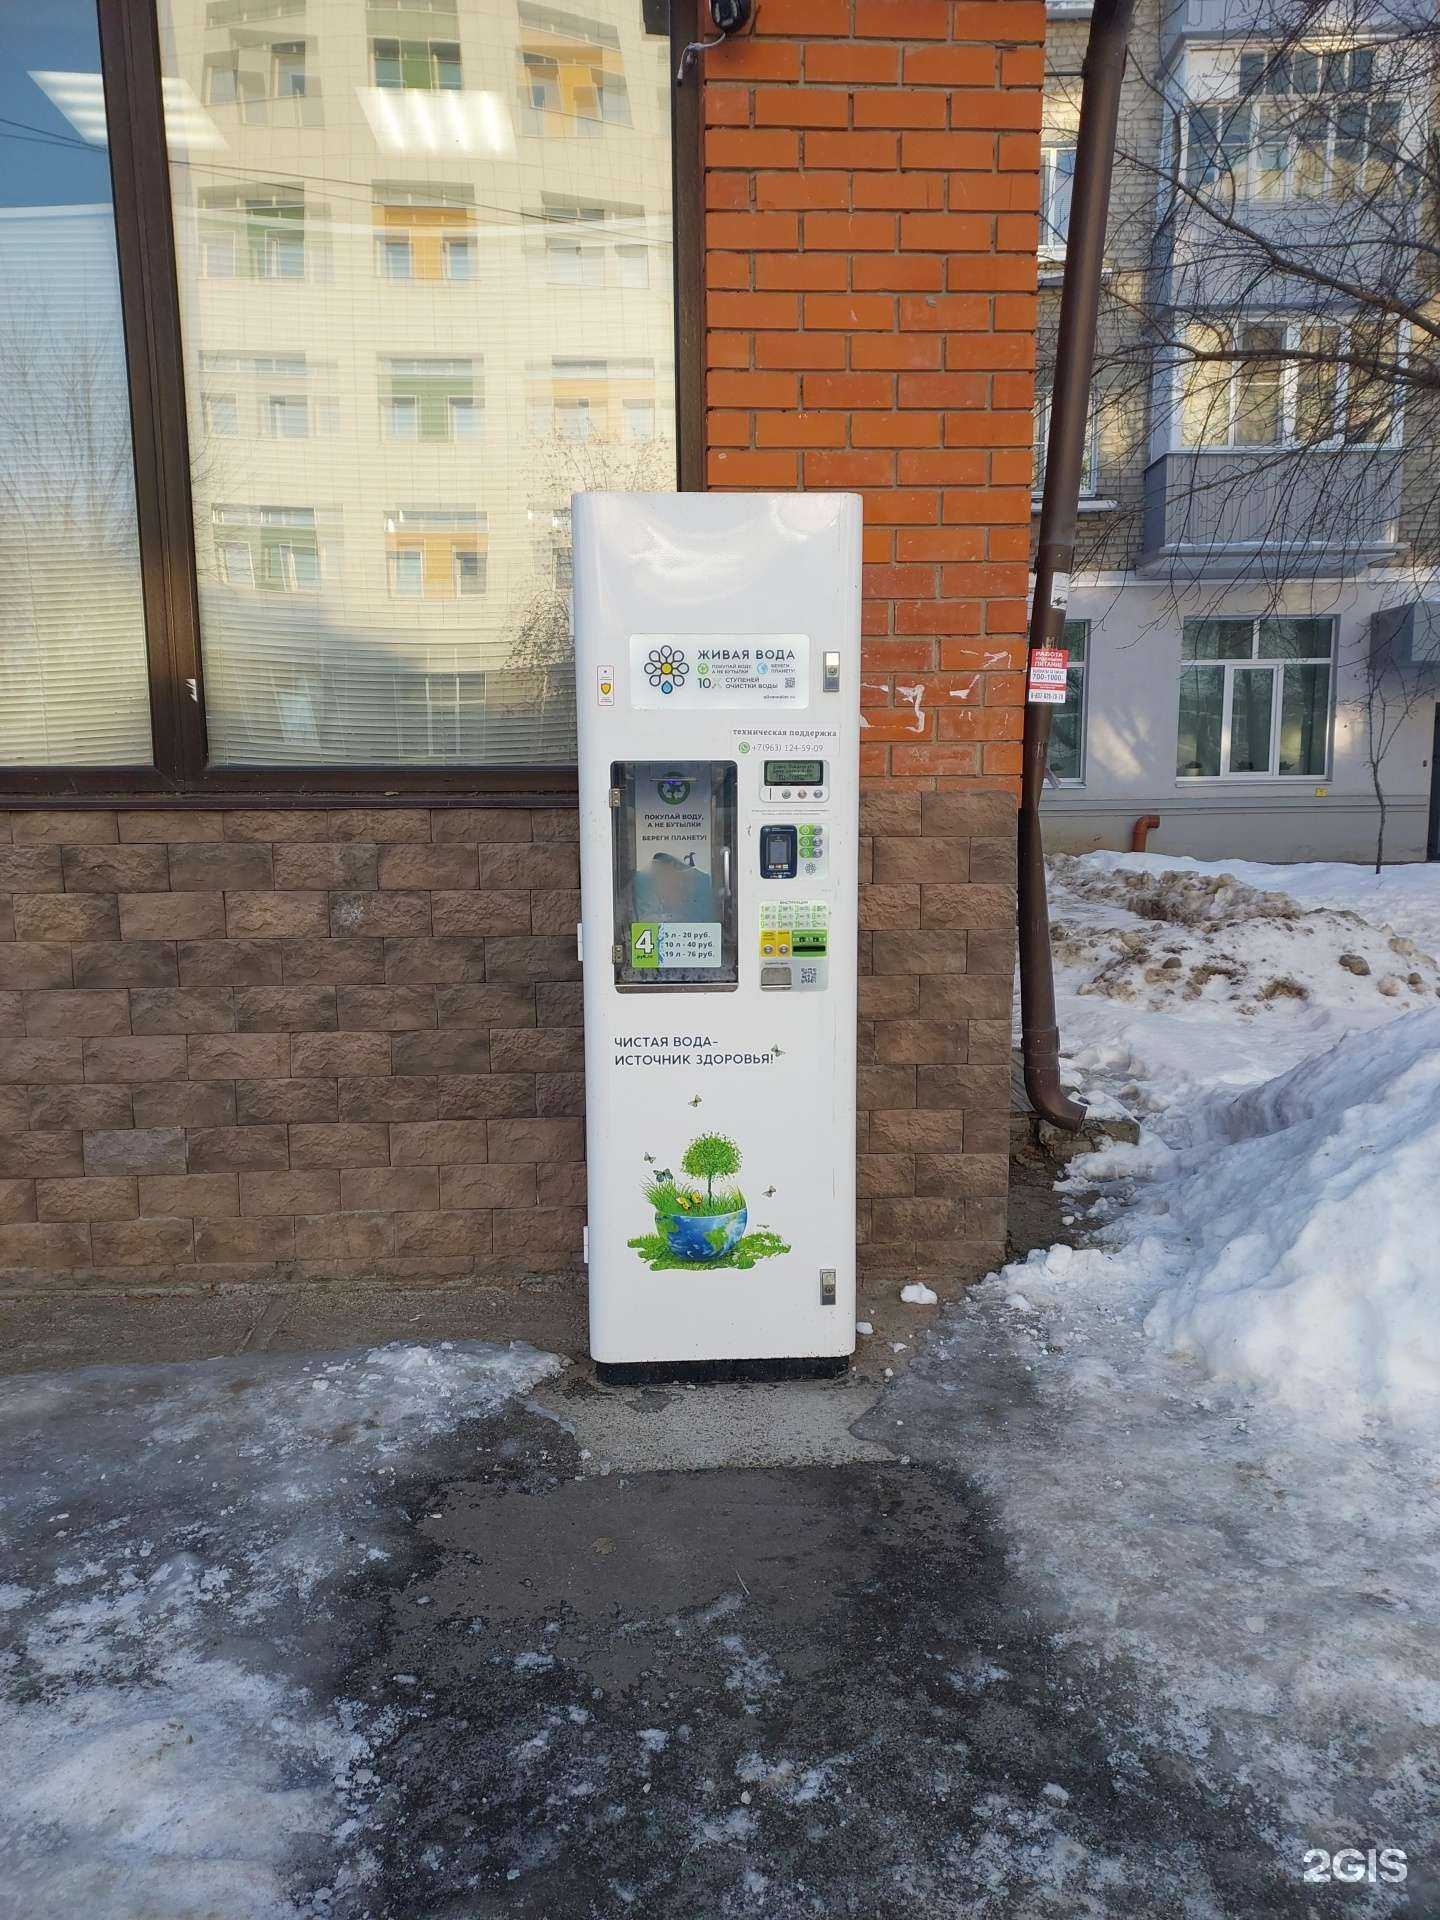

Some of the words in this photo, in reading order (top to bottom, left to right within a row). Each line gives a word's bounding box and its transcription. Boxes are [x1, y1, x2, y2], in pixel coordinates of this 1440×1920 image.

[697, 649, 750, 660] ЖИВАЯ
[756, 649, 795, 661] ВОДА
[697, 677, 712, 689] 10
[732, 729, 787, 737] техническая
[789, 729, 837, 738] поддержка
[635, 929, 654, 955] 4
[614, 1037, 669, 1048] ЧИСТАЯ
[673, 1036, 718, 1048] ВОДА-
[615, 1055, 691, 1066] ИСТОЧНИК
[696, 1053, 774, 1066] ЗДОРОВЬЯ!
